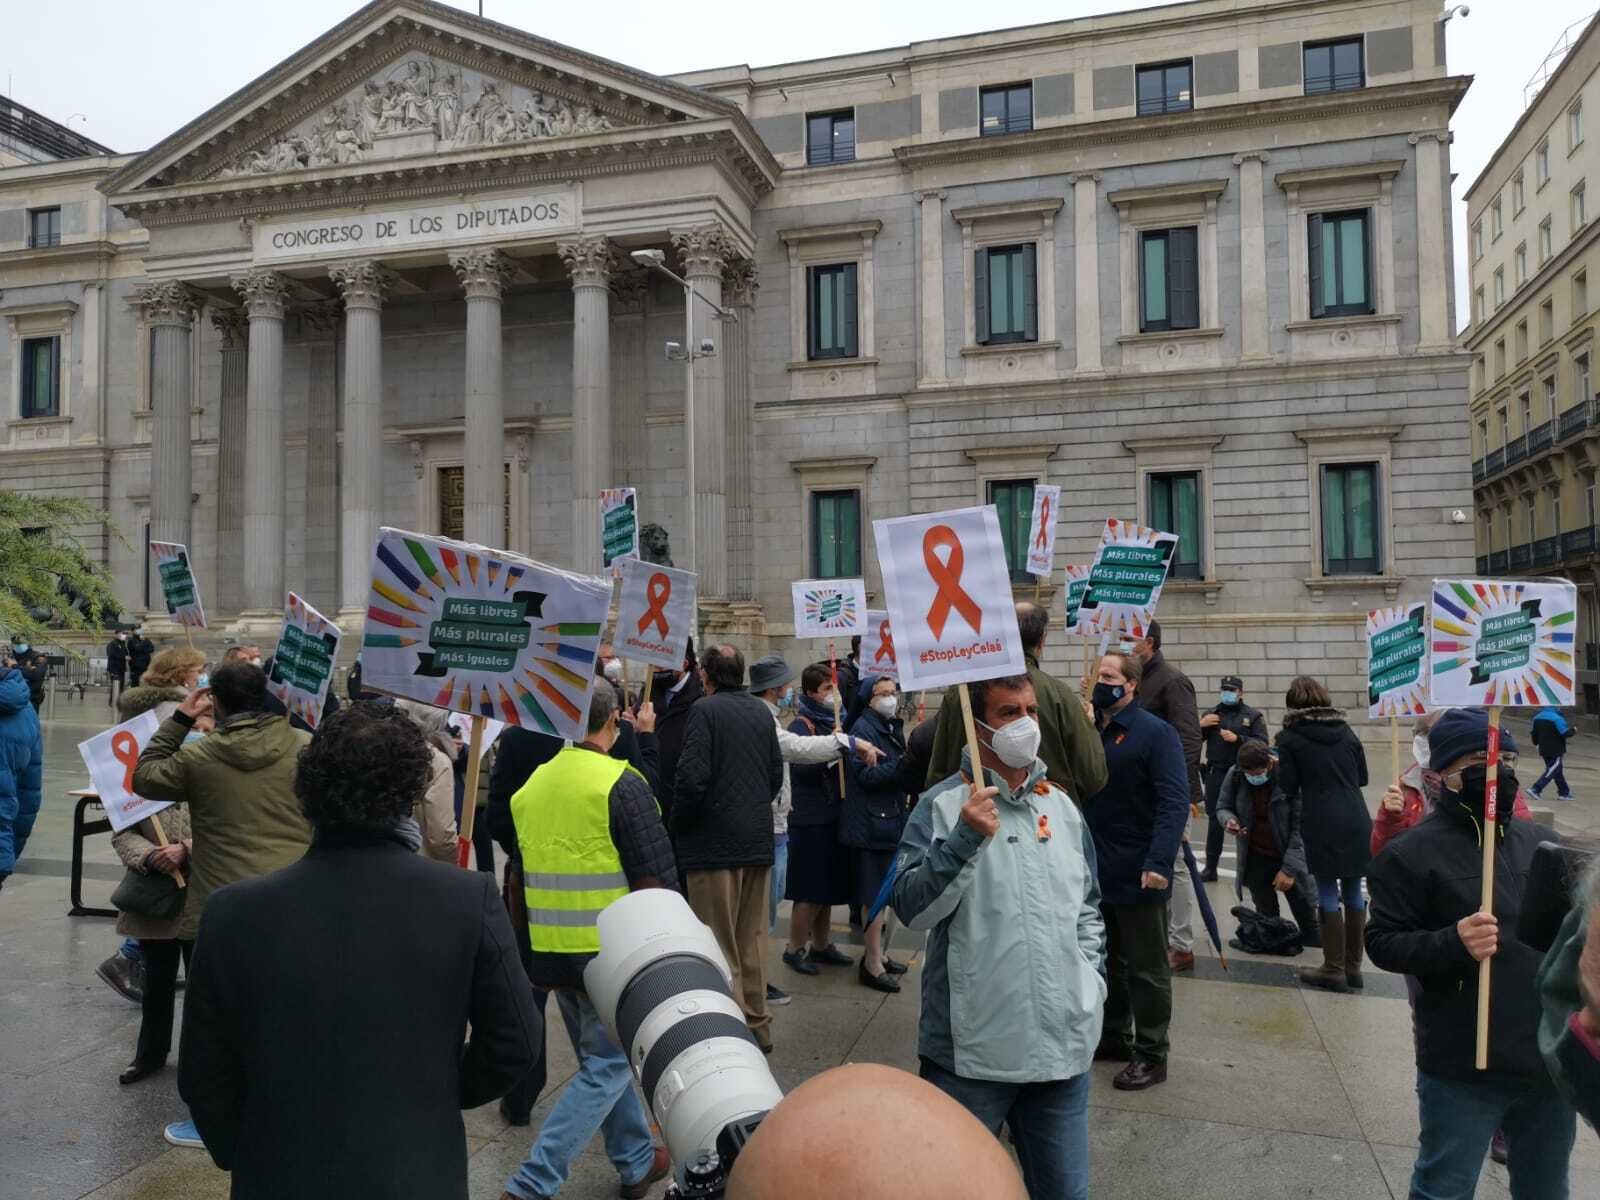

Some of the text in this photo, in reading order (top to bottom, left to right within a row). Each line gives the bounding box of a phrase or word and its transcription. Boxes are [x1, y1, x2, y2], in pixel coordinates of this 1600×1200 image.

[272, 202, 560, 249] CONGRESO DE LOS DIPUTADOS
[1106, 551, 1157, 561] Más libres
[1092, 568, 1161, 583] Más plurales
[1112, 590, 1146, 600] iguales
[449, 603, 518, 618] Más libres
[1485, 615, 1526, 632] Más libres
[433, 626, 526, 643] Más plurales
[1373, 626, 1414, 649] Más libres
[1498, 631, 1534, 649] plurales
[440, 652, 509, 666] Más iguales
[919, 638, 1003, 664] #StopLeyCelaá
[1386, 644, 1422, 667] plurales
